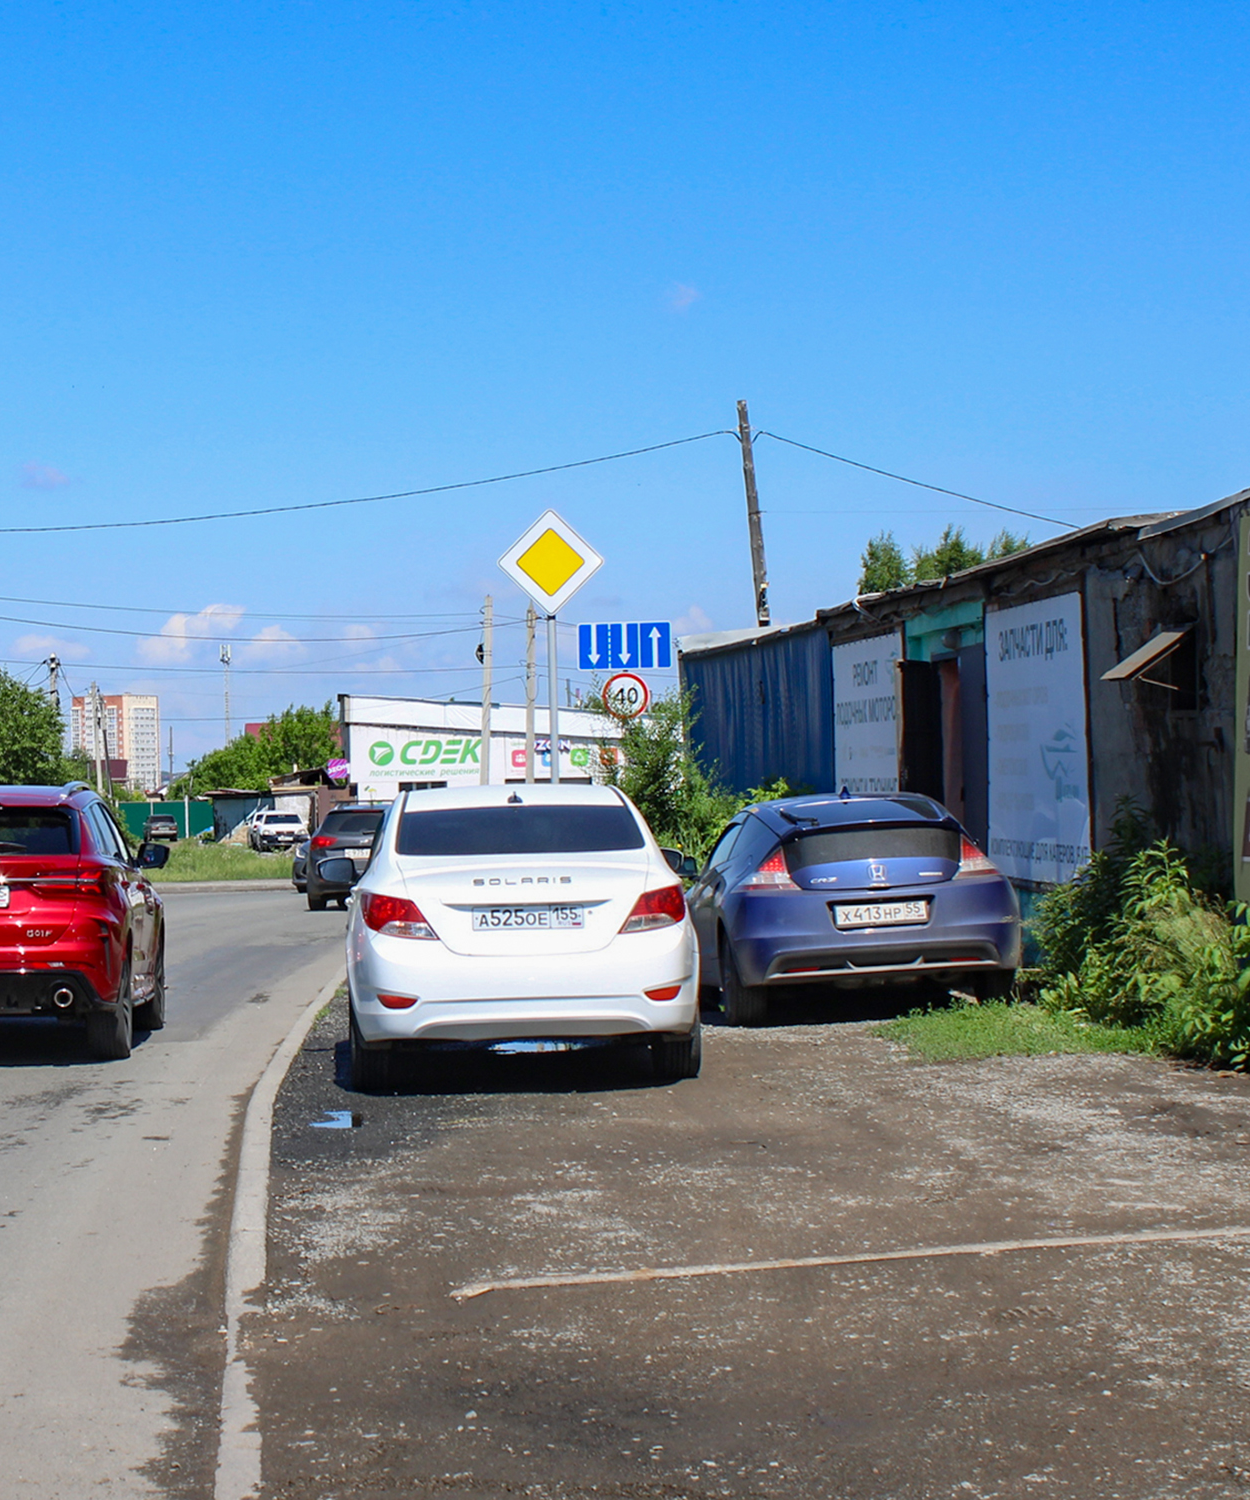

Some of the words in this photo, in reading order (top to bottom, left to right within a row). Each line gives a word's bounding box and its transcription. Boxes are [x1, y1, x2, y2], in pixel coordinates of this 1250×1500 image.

[998, 623, 1044, 662] ЗАПЧАСТИ
[1045, 618, 1068, 661] ДЛЯ:
[853, 660, 878, 688] РЕМОНТ
[613, 687, 639, 705] 40
[868, 695, 896, 723] МОТОРО
[400, 739, 482, 765] CDEK
[369, 768, 436, 777] логистические
[439, 767, 480, 777] решения
[473, 876, 571, 886] SOLARIS
[479, 908, 548, 927] А525ОЕ
[553, 906, 578, 921] 155
[842, 905, 901, 922] Х413НР
[905, 902, 921, 914] 55
